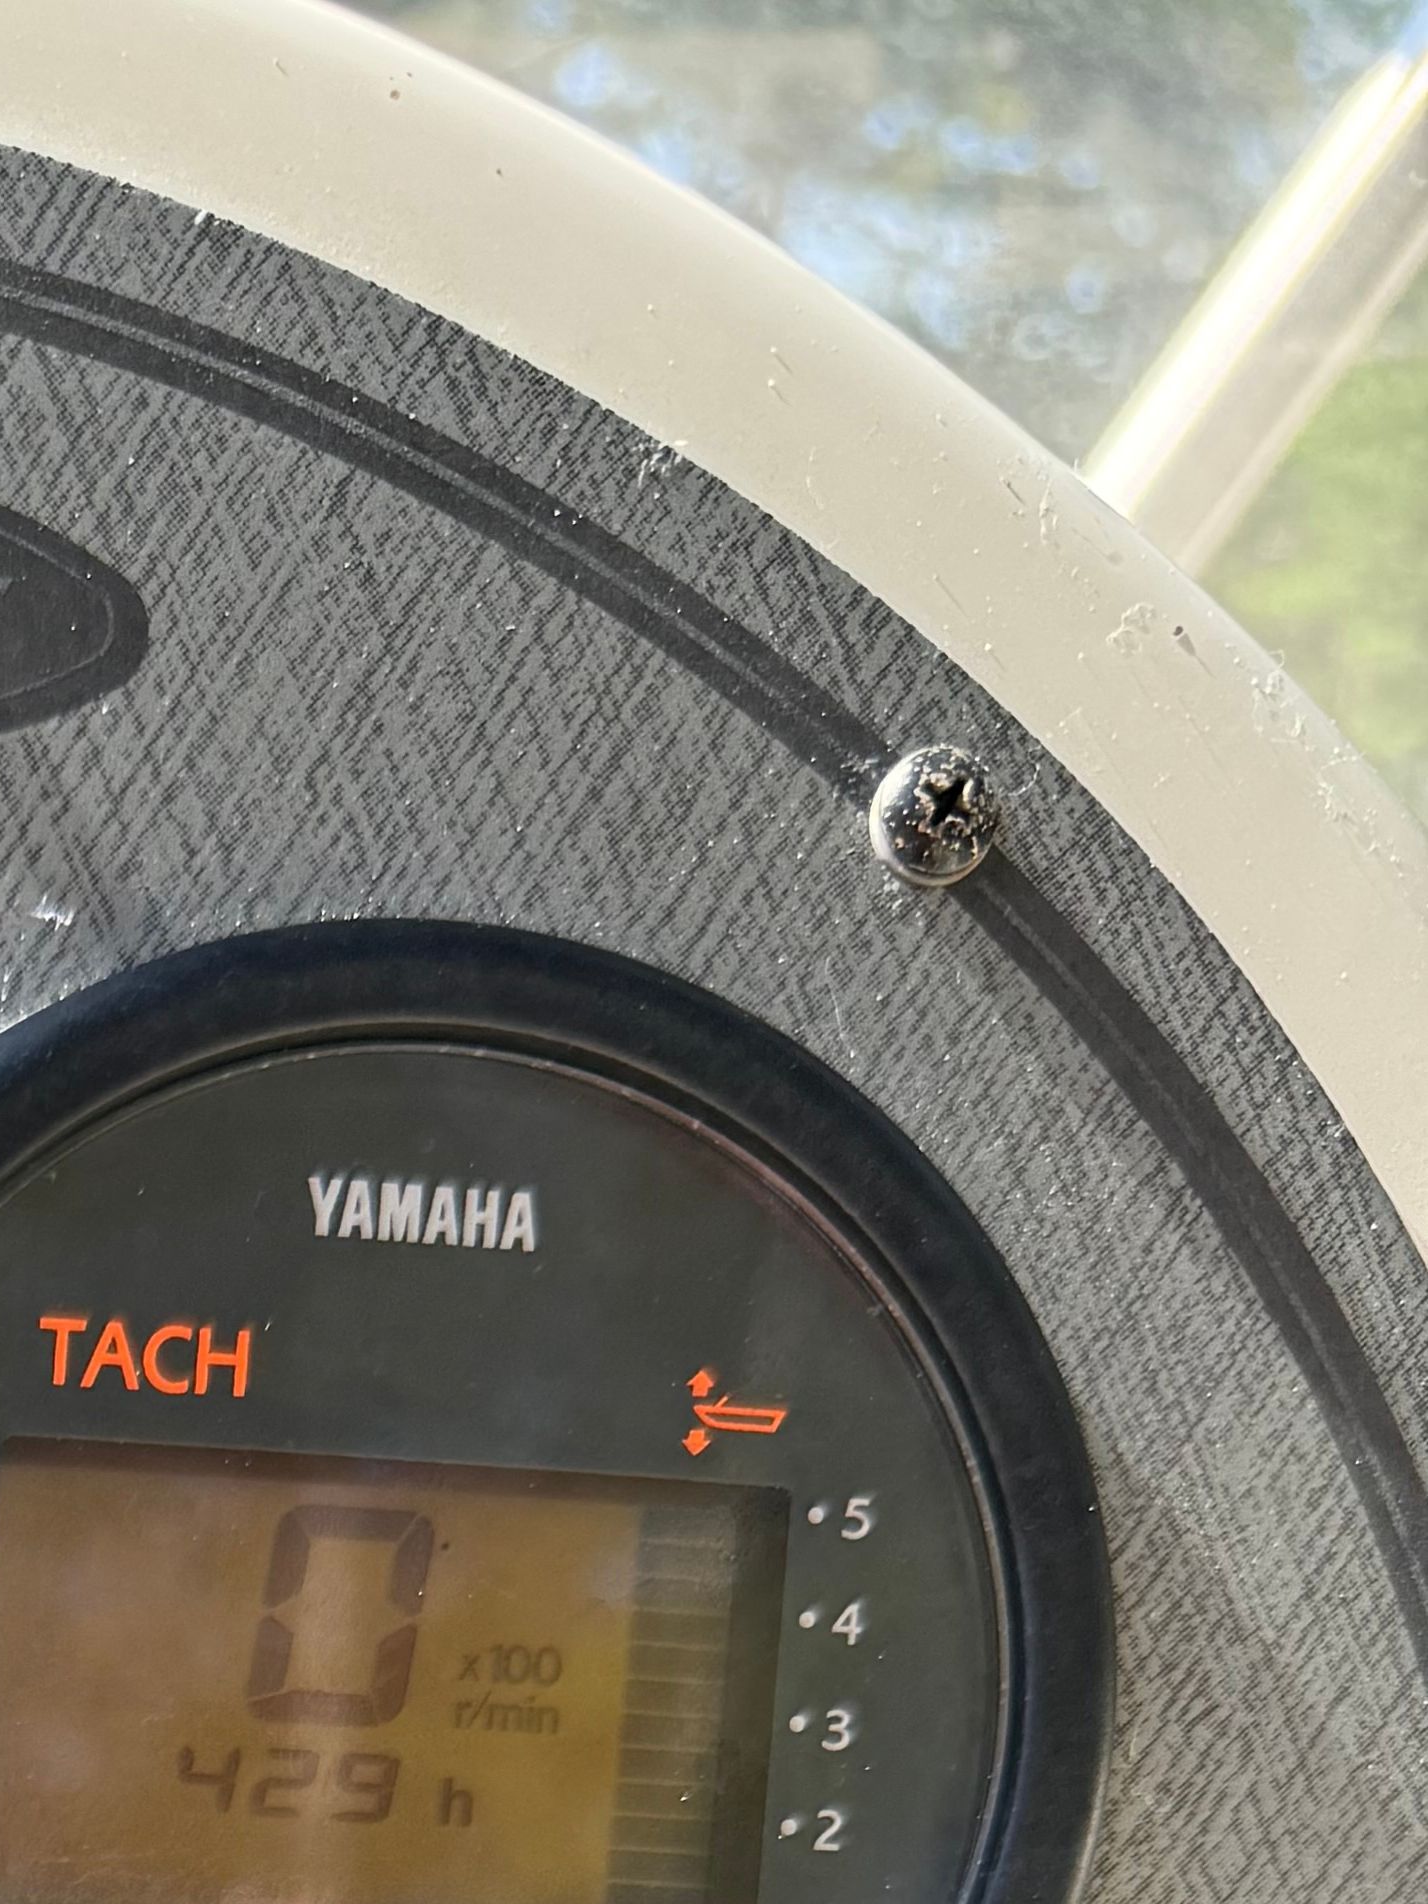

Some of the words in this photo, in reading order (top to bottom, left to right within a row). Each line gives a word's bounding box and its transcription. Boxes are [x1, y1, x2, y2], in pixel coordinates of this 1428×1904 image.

[307, 1176, 537, 1253] YAMAHA
[39, 1315, 252, 1399] TACH
[840, 1498, 873, 1540] 5
[245, 1504, 436, 1728] 0
[830, 1604, 864, 1646] 4
[451, 1692, 561, 1738] r/min
[819, 1709, 851, 1750] 3
[176, 1744, 401, 1826] 429
[438, 1776, 474, 1829] h
[812, 1812, 844, 1852] 2
